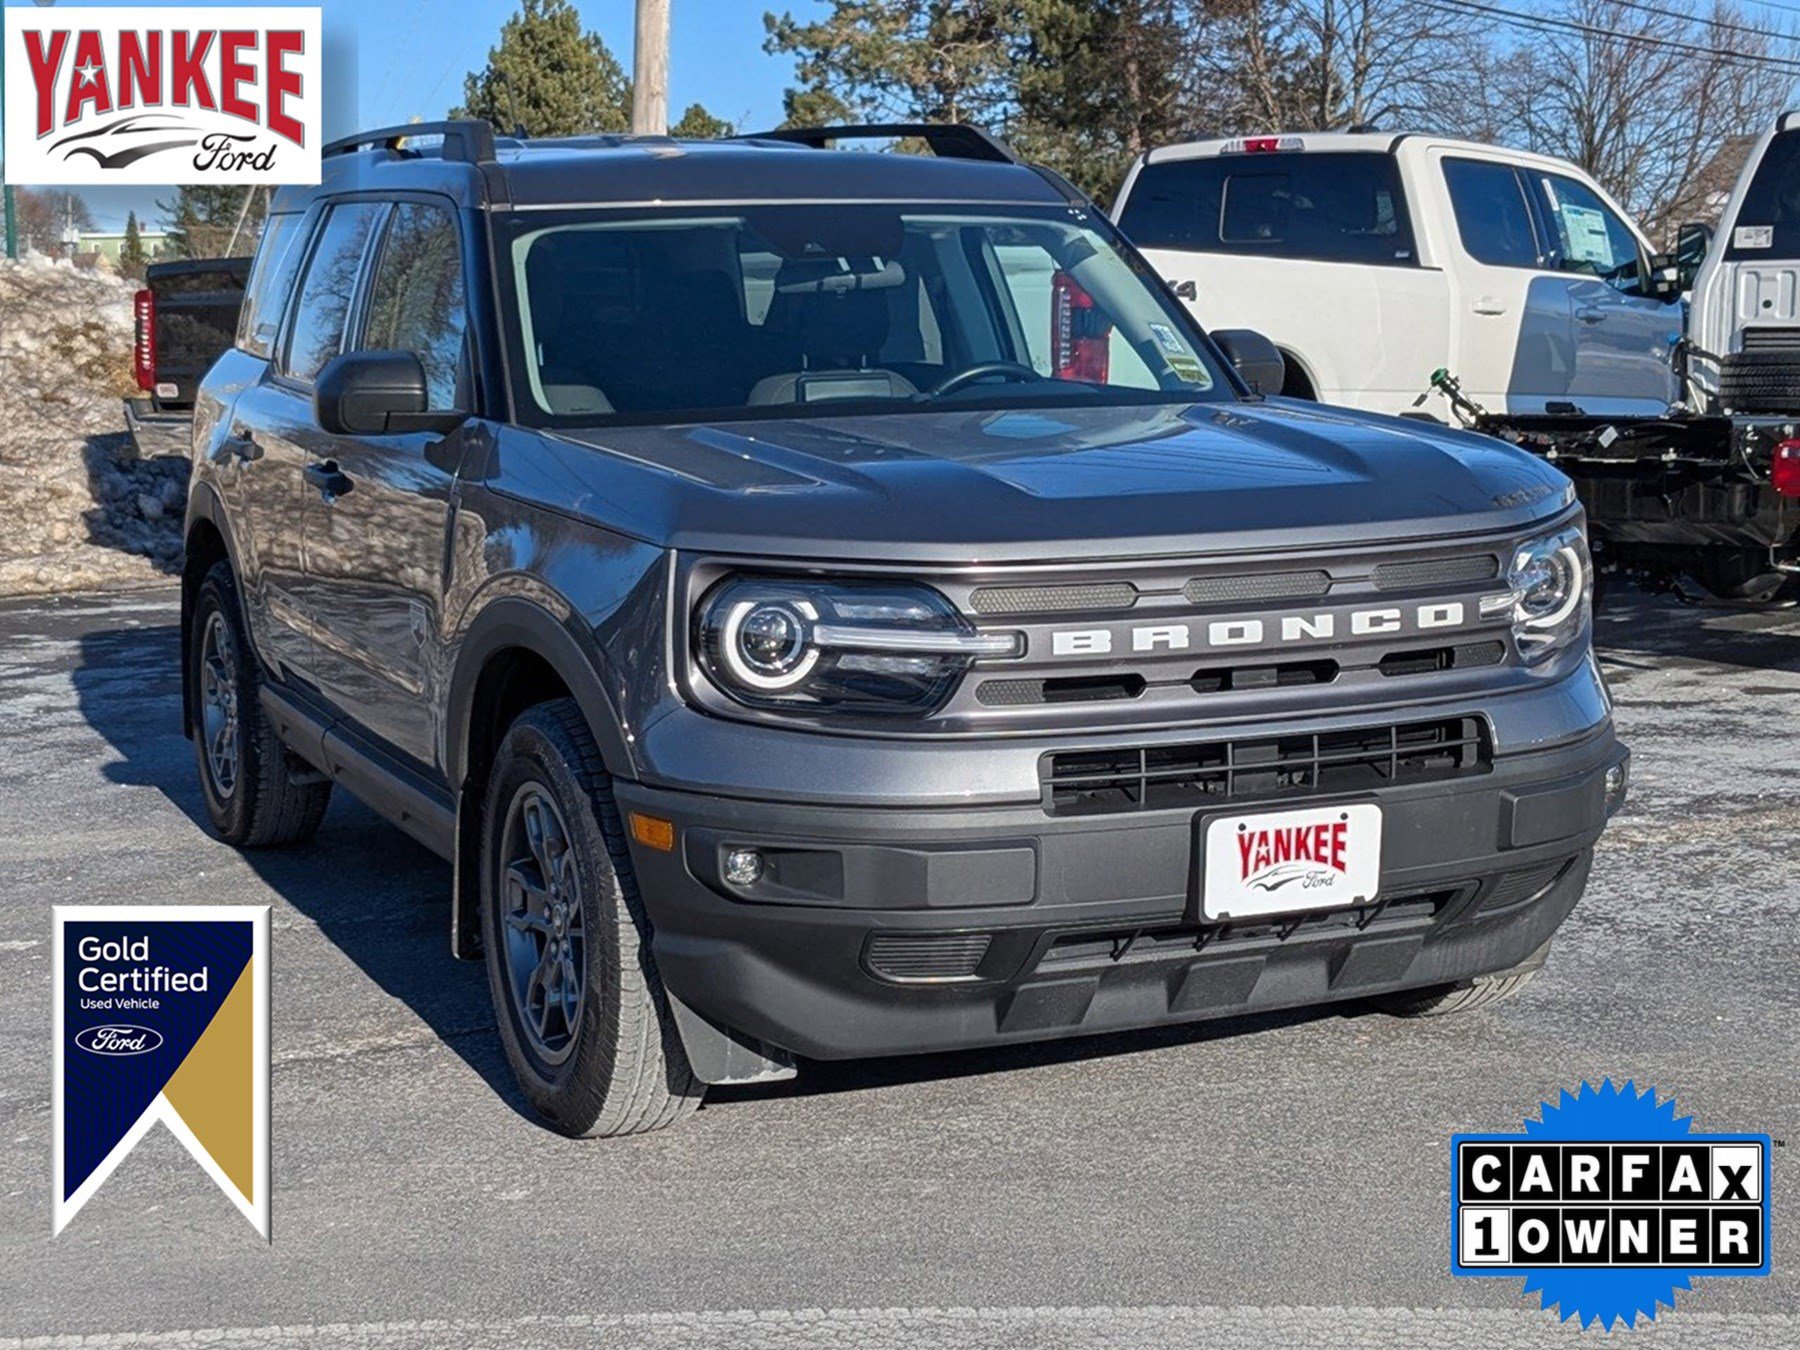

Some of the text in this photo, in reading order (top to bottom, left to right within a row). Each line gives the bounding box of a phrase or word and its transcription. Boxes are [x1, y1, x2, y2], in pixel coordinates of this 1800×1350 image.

[1052, 602, 1464, 656] BRONCO
[1236, 822, 1348, 882] YANKEE
[1301, 870, 1336, 889] Ford
